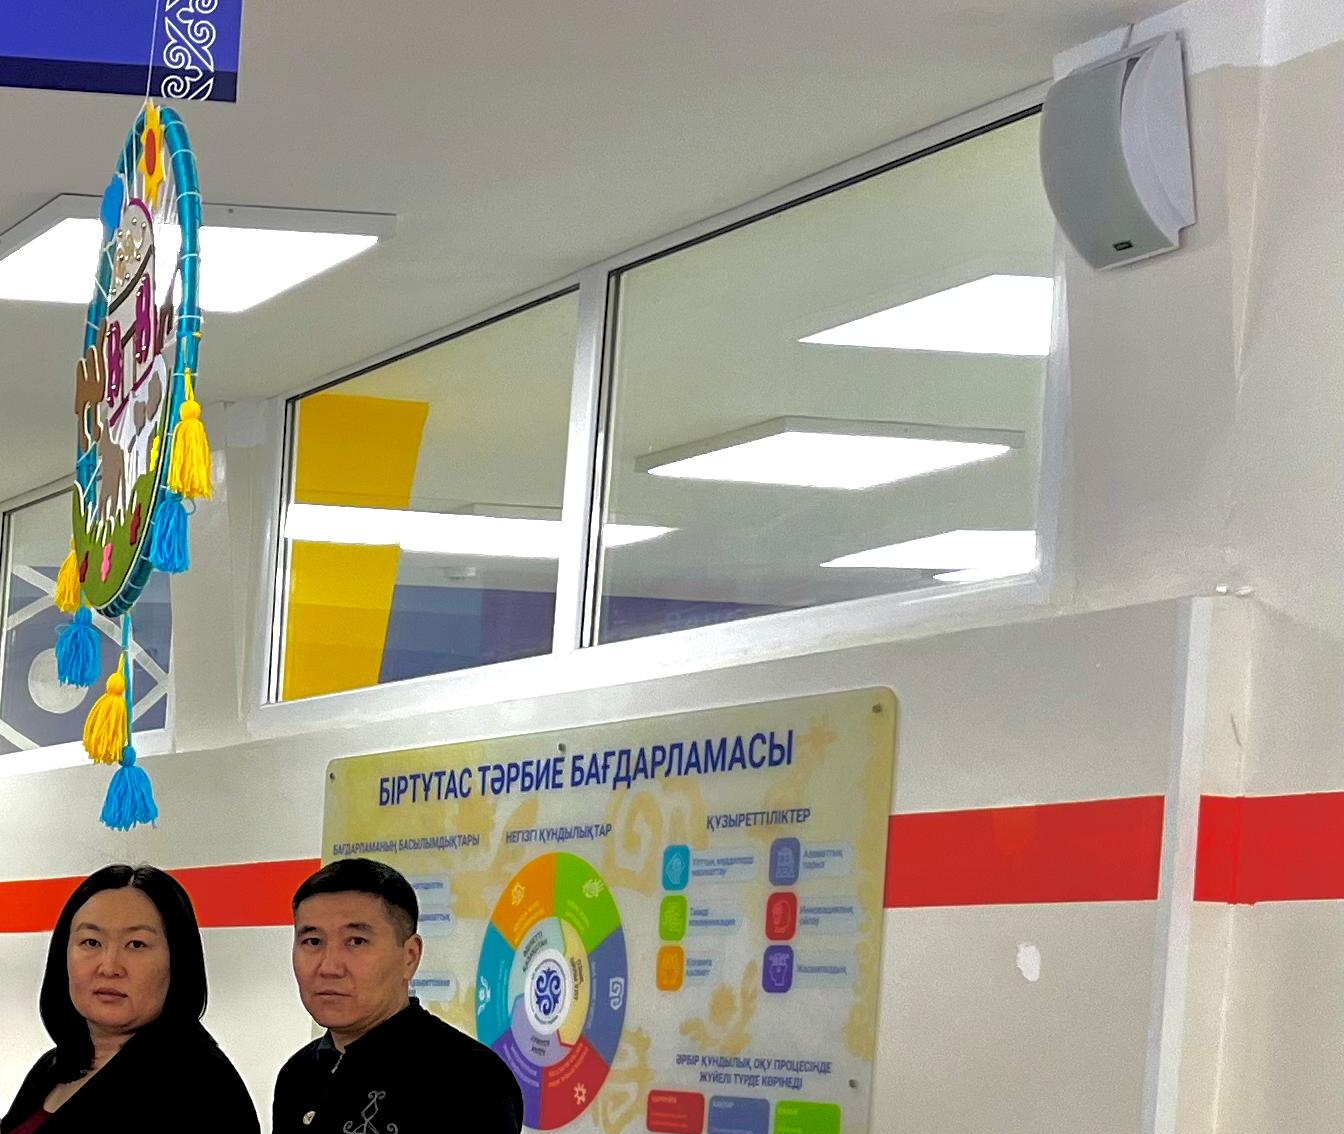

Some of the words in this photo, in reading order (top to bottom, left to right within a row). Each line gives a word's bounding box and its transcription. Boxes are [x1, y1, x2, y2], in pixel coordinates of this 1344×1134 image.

[378, 770, 473, 808] БІРТҰТАС
[478, 755, 566, 798] ТӘРБИЕ
[570, 729, 795, 791] БАҒДАРЛАМАСЫ
